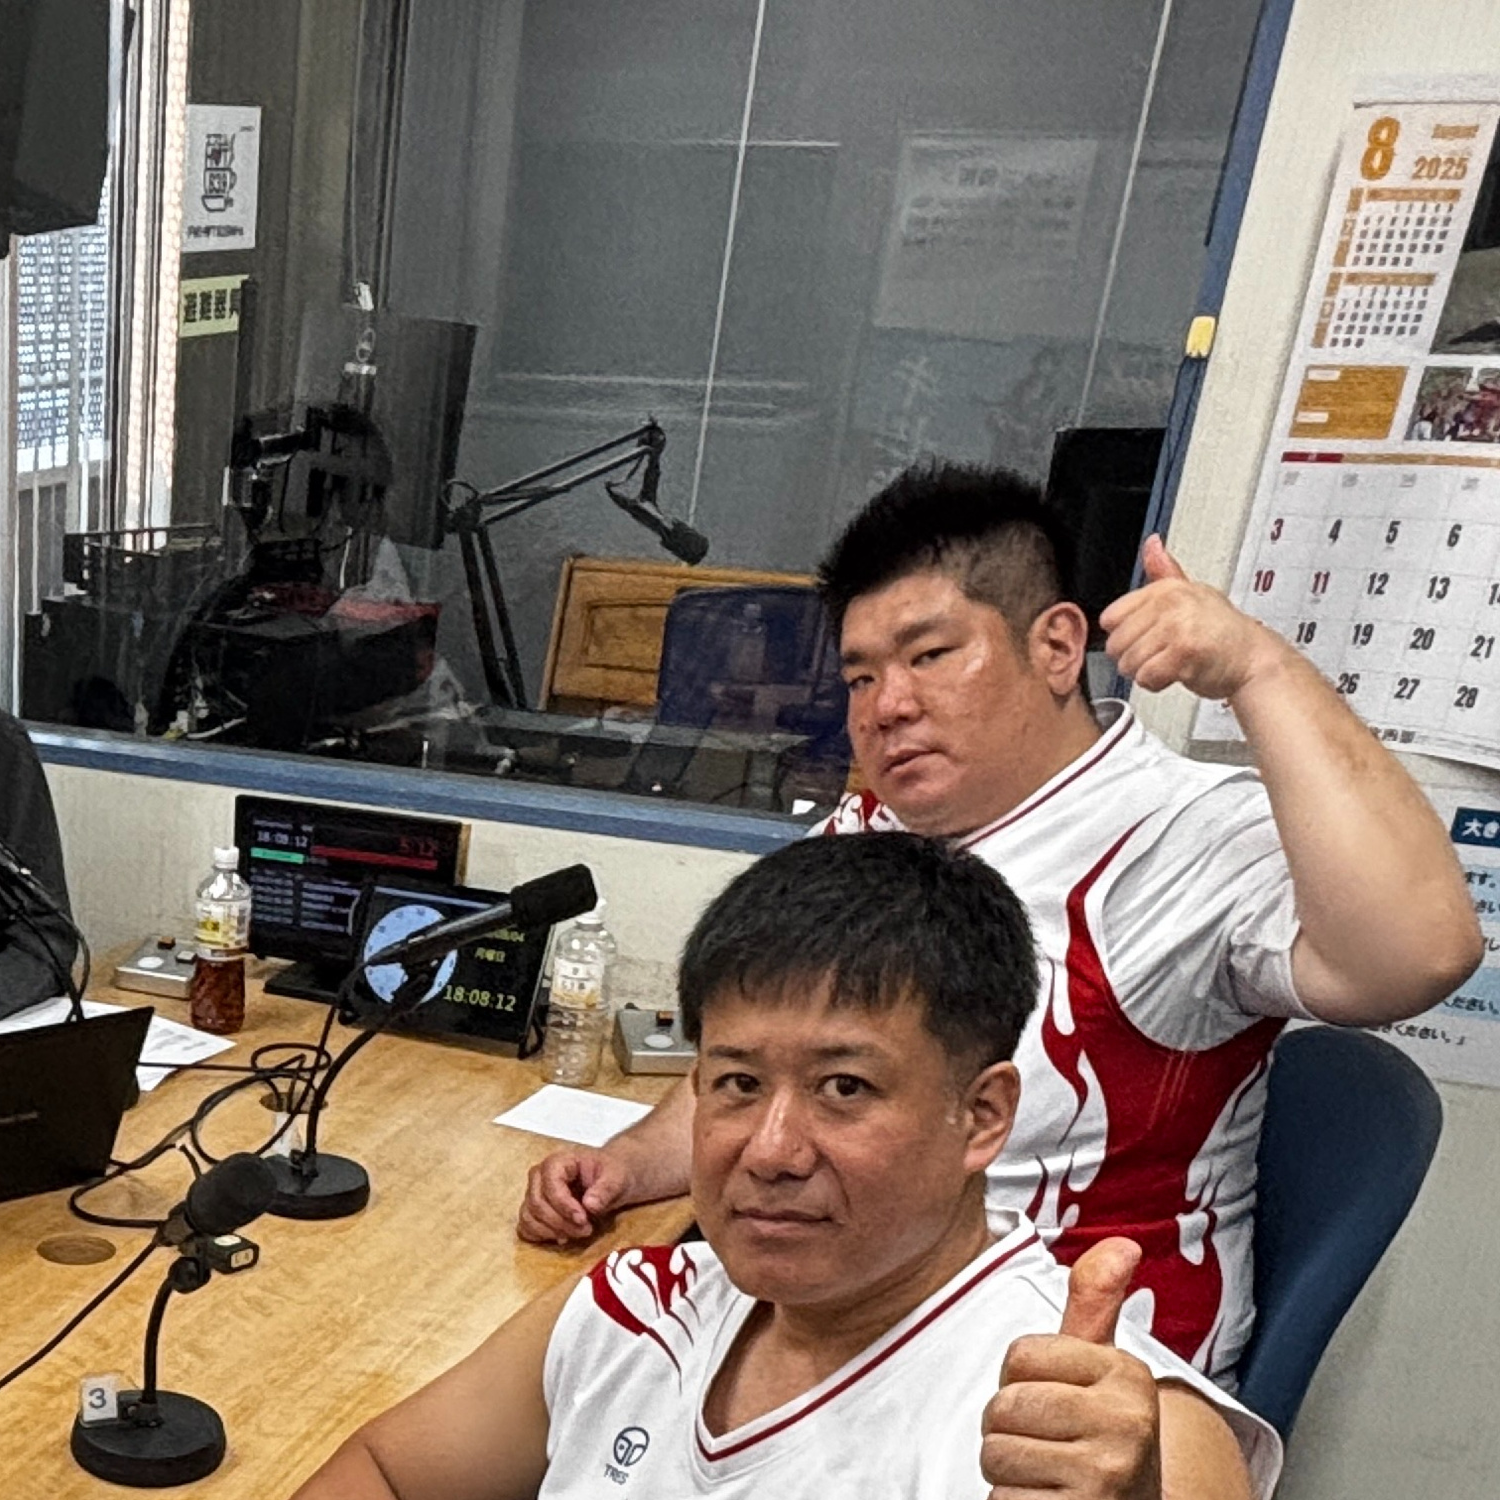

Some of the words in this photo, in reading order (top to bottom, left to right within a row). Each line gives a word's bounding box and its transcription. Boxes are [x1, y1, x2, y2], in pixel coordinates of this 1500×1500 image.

[1361, 116, 1400, 180] 8
[1411, 156, 1469, 180] 2025
[1270, 518, 1284, 541] 3
[1328, 519, 1342, 543] 4
[1385, 520, 1400, 544] 5
[1447, 524, 1461, 547] 6
[1253, 570, 1275, 593] 10
[1312, 571, 1330, 594] 11
[1366, 573, 1389, 595] 12
[1427, 576, 1449, 599] 13
[1296, 622, 1316, 643] 18
[1352, 624, 1374, 645] 19
[1410, 628, 1435, 650] 20
[1470, 635, 1495, 659] 21
[1336, 673, 1359, 694] 26
[1394, 678, 1420, 700] 27
[1454, 686, 1479, 708] 28
[443, 985, 517, 1012] 18:08:12
[88, 1387, 107, 1409] 3
[603, 1462, 629, 1485] TRES
